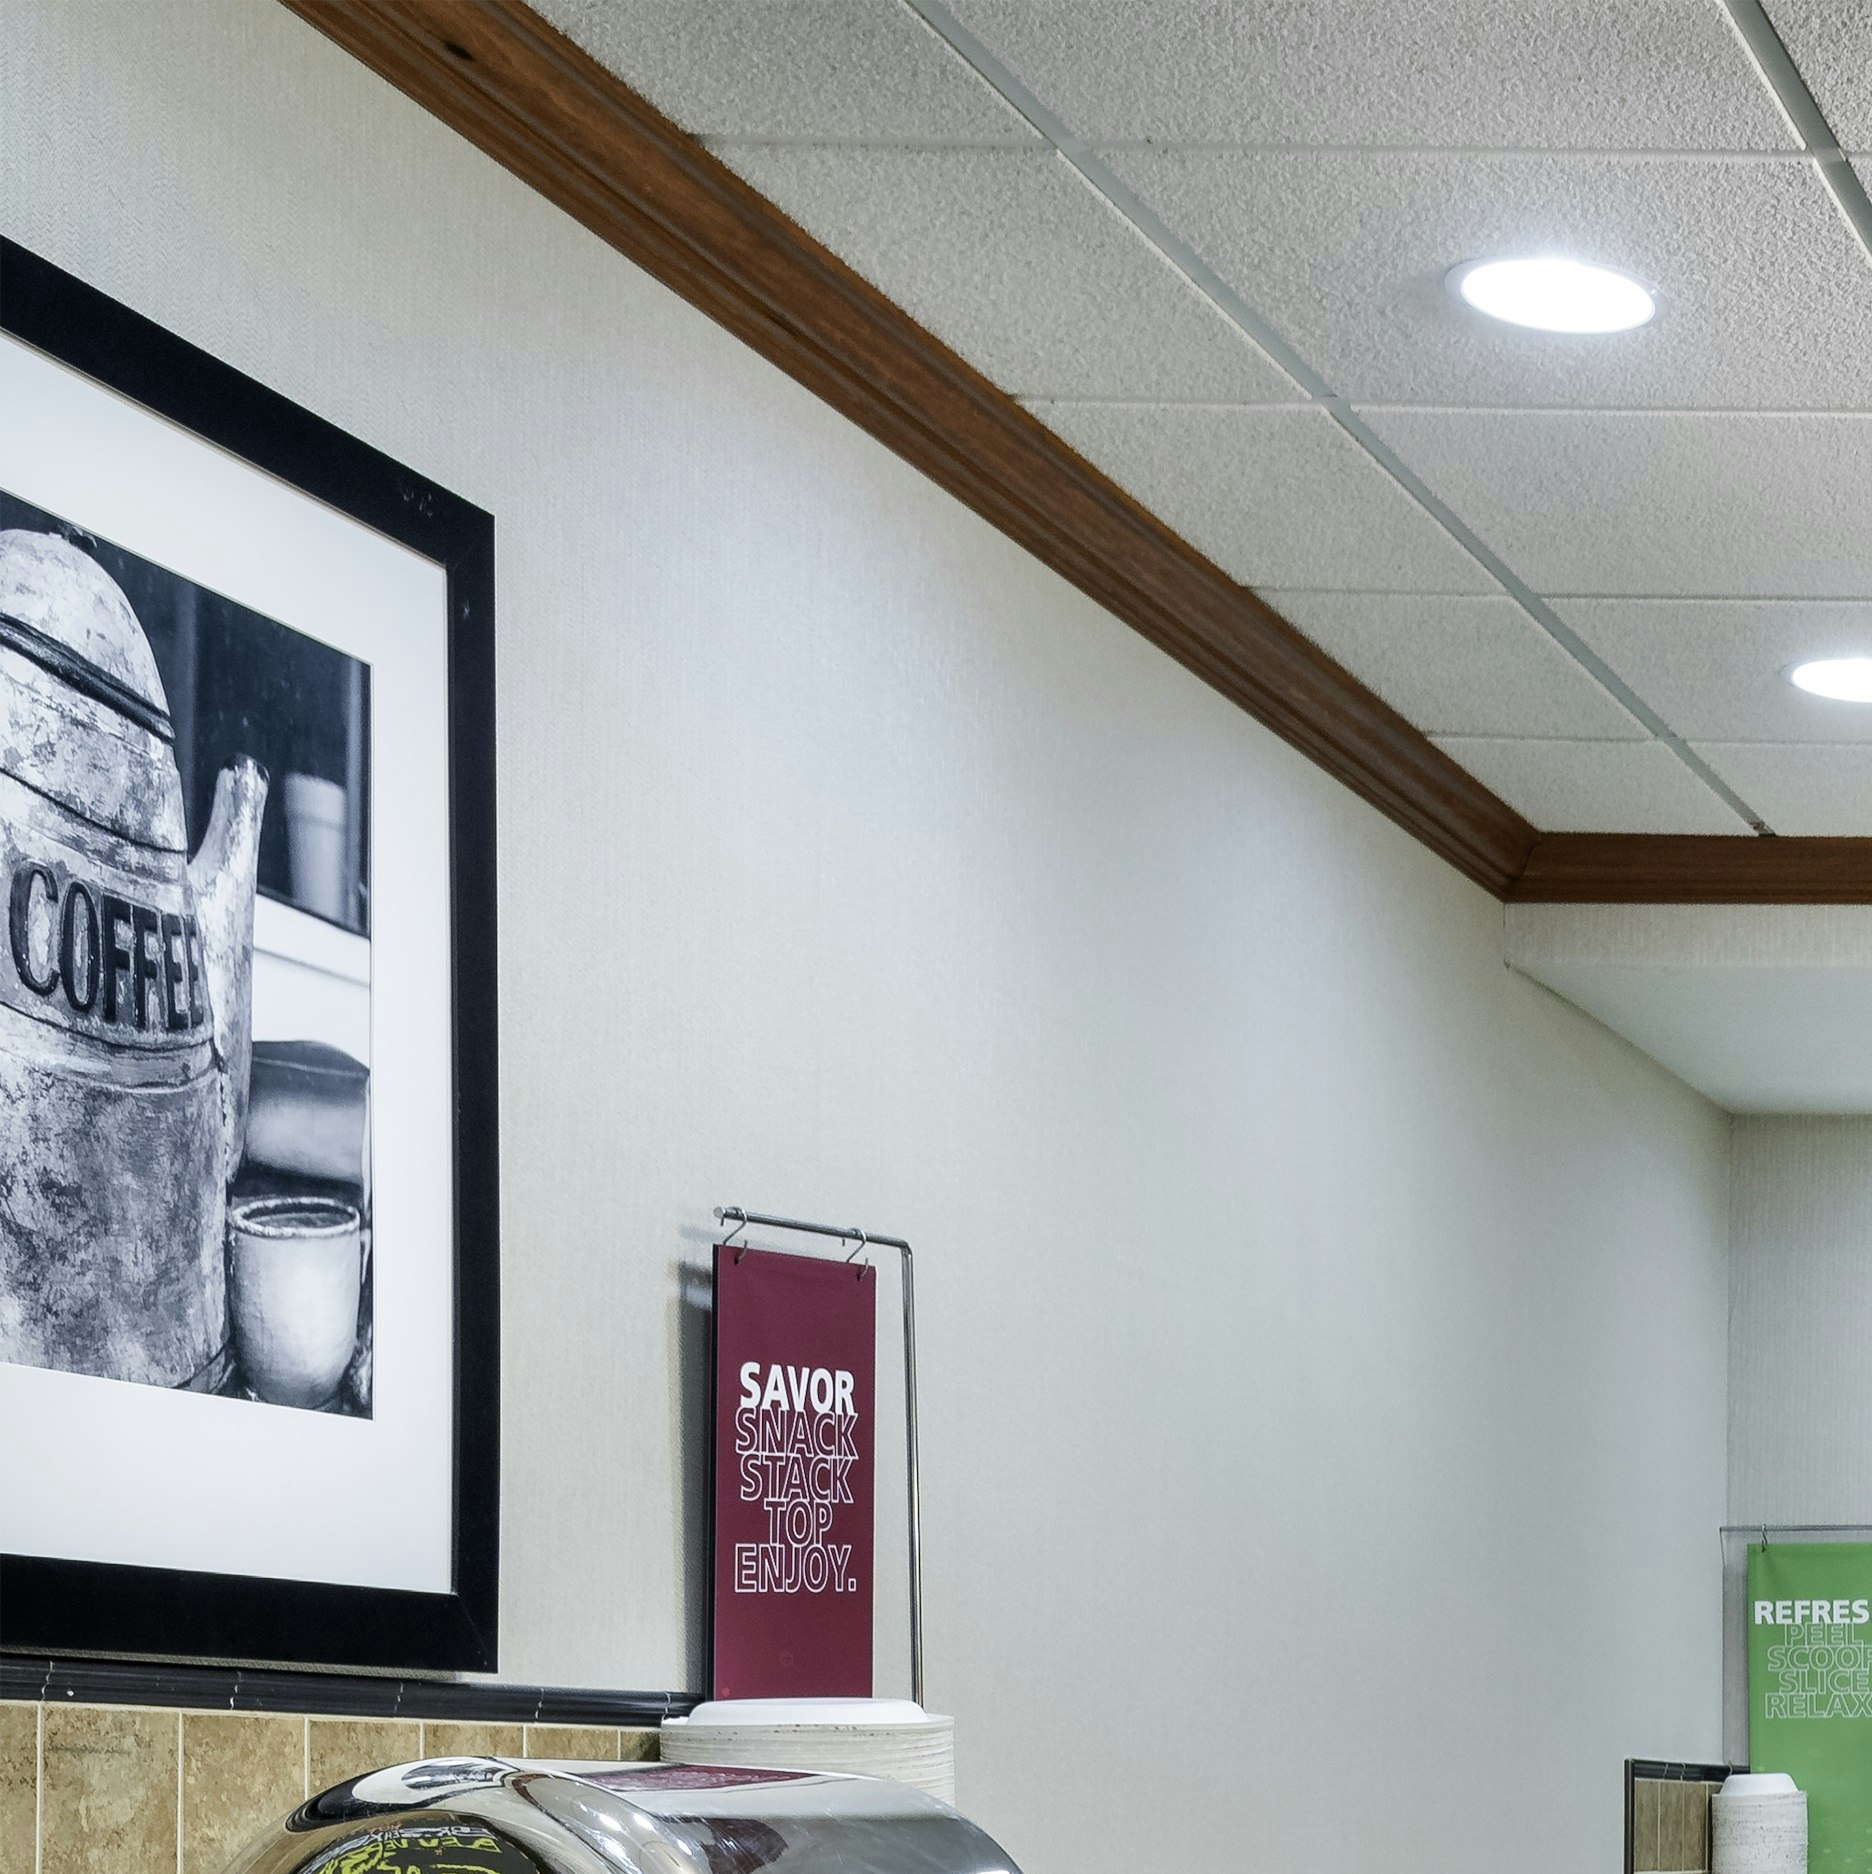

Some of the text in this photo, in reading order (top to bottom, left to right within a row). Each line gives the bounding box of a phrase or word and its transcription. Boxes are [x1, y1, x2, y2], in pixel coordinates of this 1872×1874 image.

[9, 858, 204, 1032] COFFEE
[740, 1361, 855, 1415] SAVOR
[734, 1407, 859, 1460] SNACK
[740, 1453, 853, 1504] STACK
[764, 1500, 833, 1547] TOP
[734, 1543, 857, 1594] ENJOY.
[1785, 1622, 1865, 1647] PEEL
[1778, 1668, 1870, 1695] SLICE
